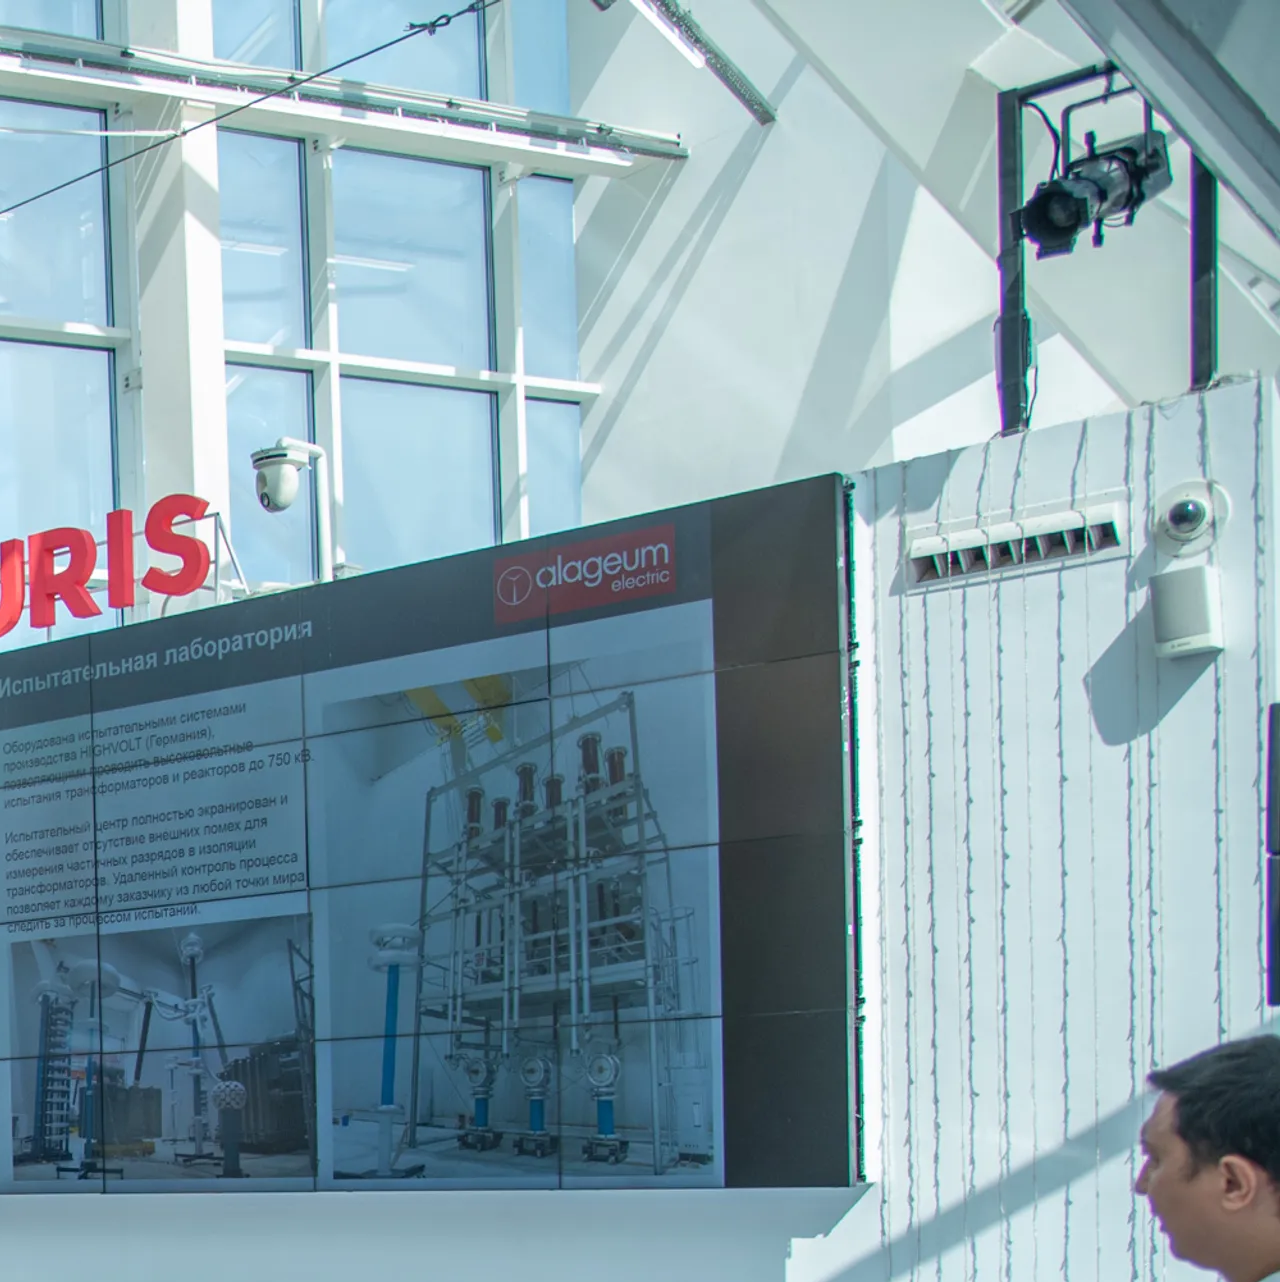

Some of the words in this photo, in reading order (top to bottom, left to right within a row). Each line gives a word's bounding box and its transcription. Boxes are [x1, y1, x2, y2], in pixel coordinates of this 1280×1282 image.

[536, 542, 669, 588] alageum
[611, 568, 670, 592] electric
[164, 621, 312, 665] лаборатория
[3, 733, 75, 755] Оборудована
[78, 715, 177, 740] испытательными
[180, 703, 246, 724] системами
[3, 750, 77, 772] производства
[81, 737, 142, 759] HIGHVOLT
[145, 726, 215, 750] (Германия),
[153, 741, 253, 767] высоковольтные
[4, 790, 61, 809] испытания
[65, 774, 169, 800] трансформаторов
[173, 773, 180, 781] и
[183, 762, 245, 784] реакторов
[248, 759, 264, 772] до
[268, 752, 290, 768] 750
[5, 821, 90, 844] Испытательный
[96, 818, 128, 834] центр
[131, 808, 194, 826] полностью
[198, 797, 276, 817] экранирован
[281, 795, 287, 805] и
[5, 842, 79, 862] обеспечивает
[82, 835, 145, 851] отсутствие
[149, 827, 200, 843] внешних
[204, 822, 241, 835] помех
[244, 817, 268, 831] для
[6, 863, 64, 880] измерения
[67, 856, 127, 871] частичных
[130, 848, 184, 865] разрядов
[189, 847, 195, 857] в
[199, 838, 256, 855] изоляции
[112, 866, 177, 886] Удаленный
[181, 860, 236, 876] контроль
[240, 853, 298, 871] процесса
[7, 900, 61, 916] позволяет
[64, 894, 116, 909] каждому
[117, 888, 172, 902] заказчику
[177, 886, 189, 895] из
[193, 879, 231, 894] любой
[235, 875, 269, 888] точки
[273, 872, 305, 886] мира
[8, 919, 50, 933] следить
[54, 918, 65, 927] за
[69, 912, 131, 927] процессом
